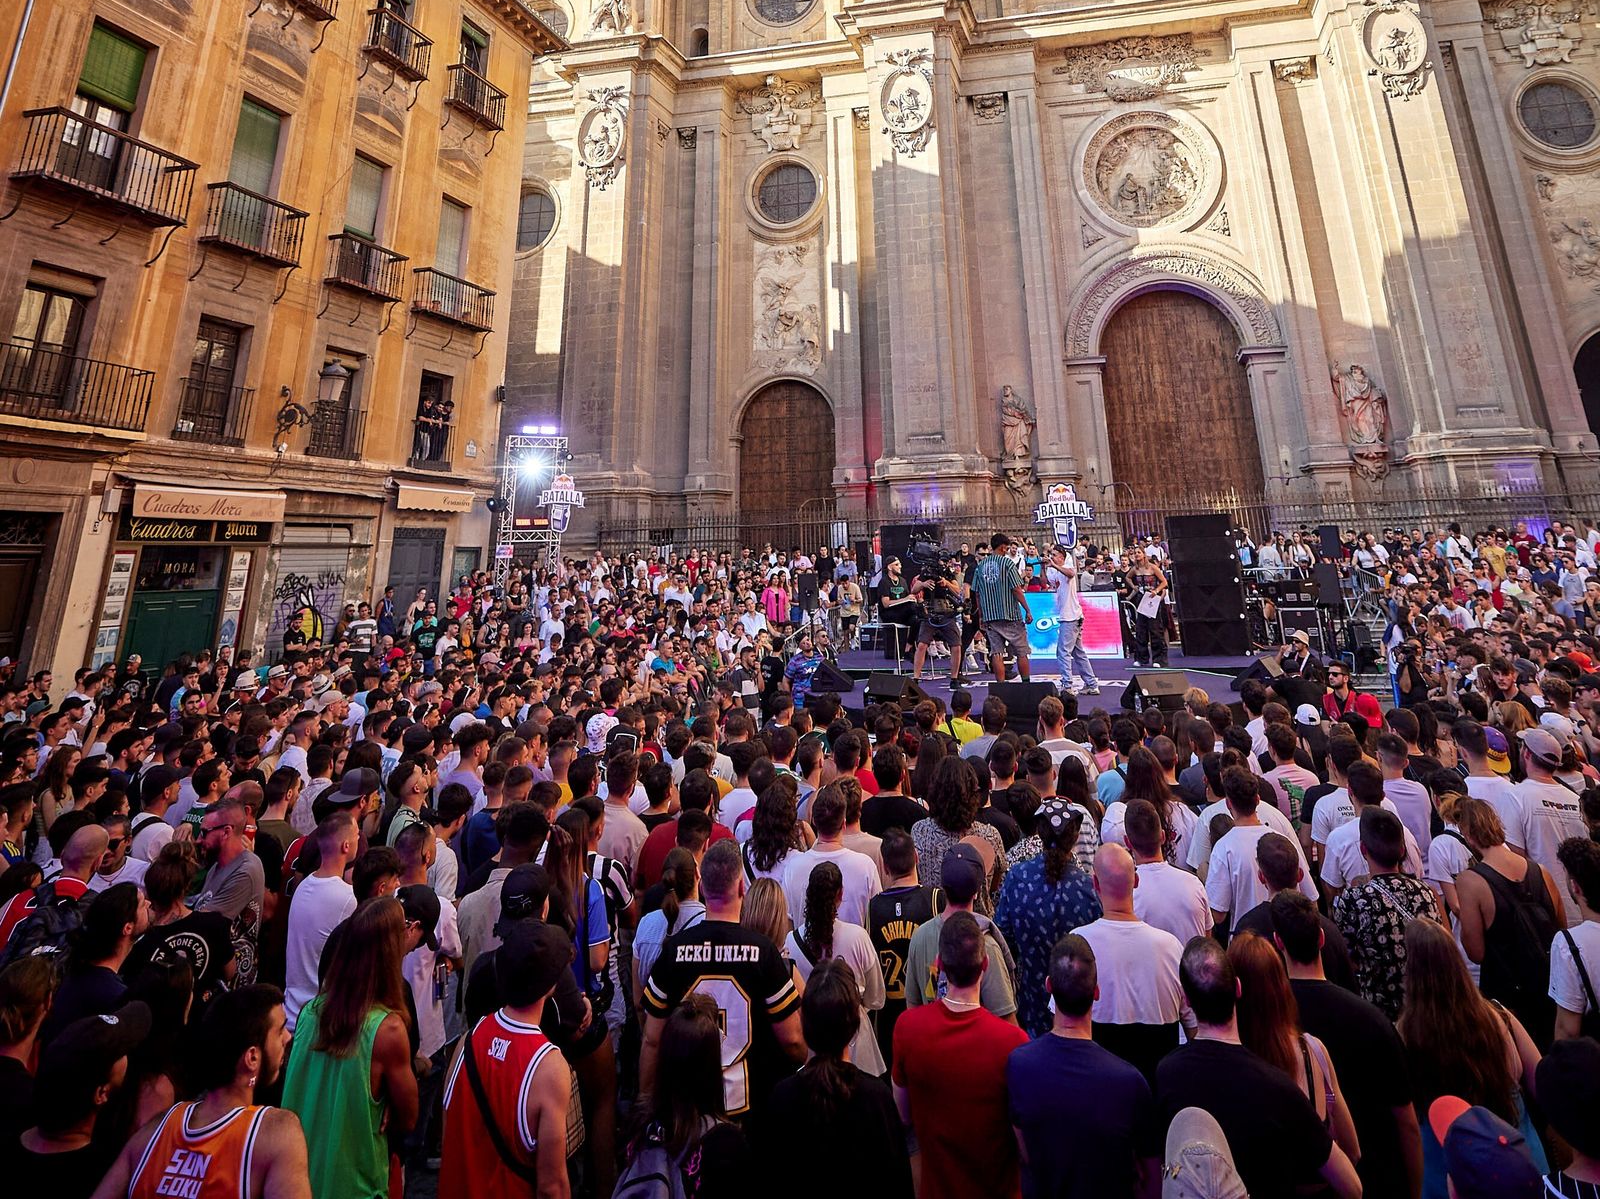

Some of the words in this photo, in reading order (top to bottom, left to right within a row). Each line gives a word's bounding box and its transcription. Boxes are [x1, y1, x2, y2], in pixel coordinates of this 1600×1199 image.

[143, 493, 201, 515] Cuadros
[203, 497, 242, 516] Mora
[543, 491, 580, 503] BATALLA
[1041, 502, 1086, 517] BATALLA
[130, 518, 197, 539] Cuadros
[225, 521, 258, 539] Mora
[163, 562, 196, 574] MORA
[168, 938, 194, 949] STONE
[191, 942, 206, 968] CREW
[714, 944, 760, 963] UNLTD
[165, 1148, 213, 1179] SON
[156, 1175, 203, 1199] GOKU
